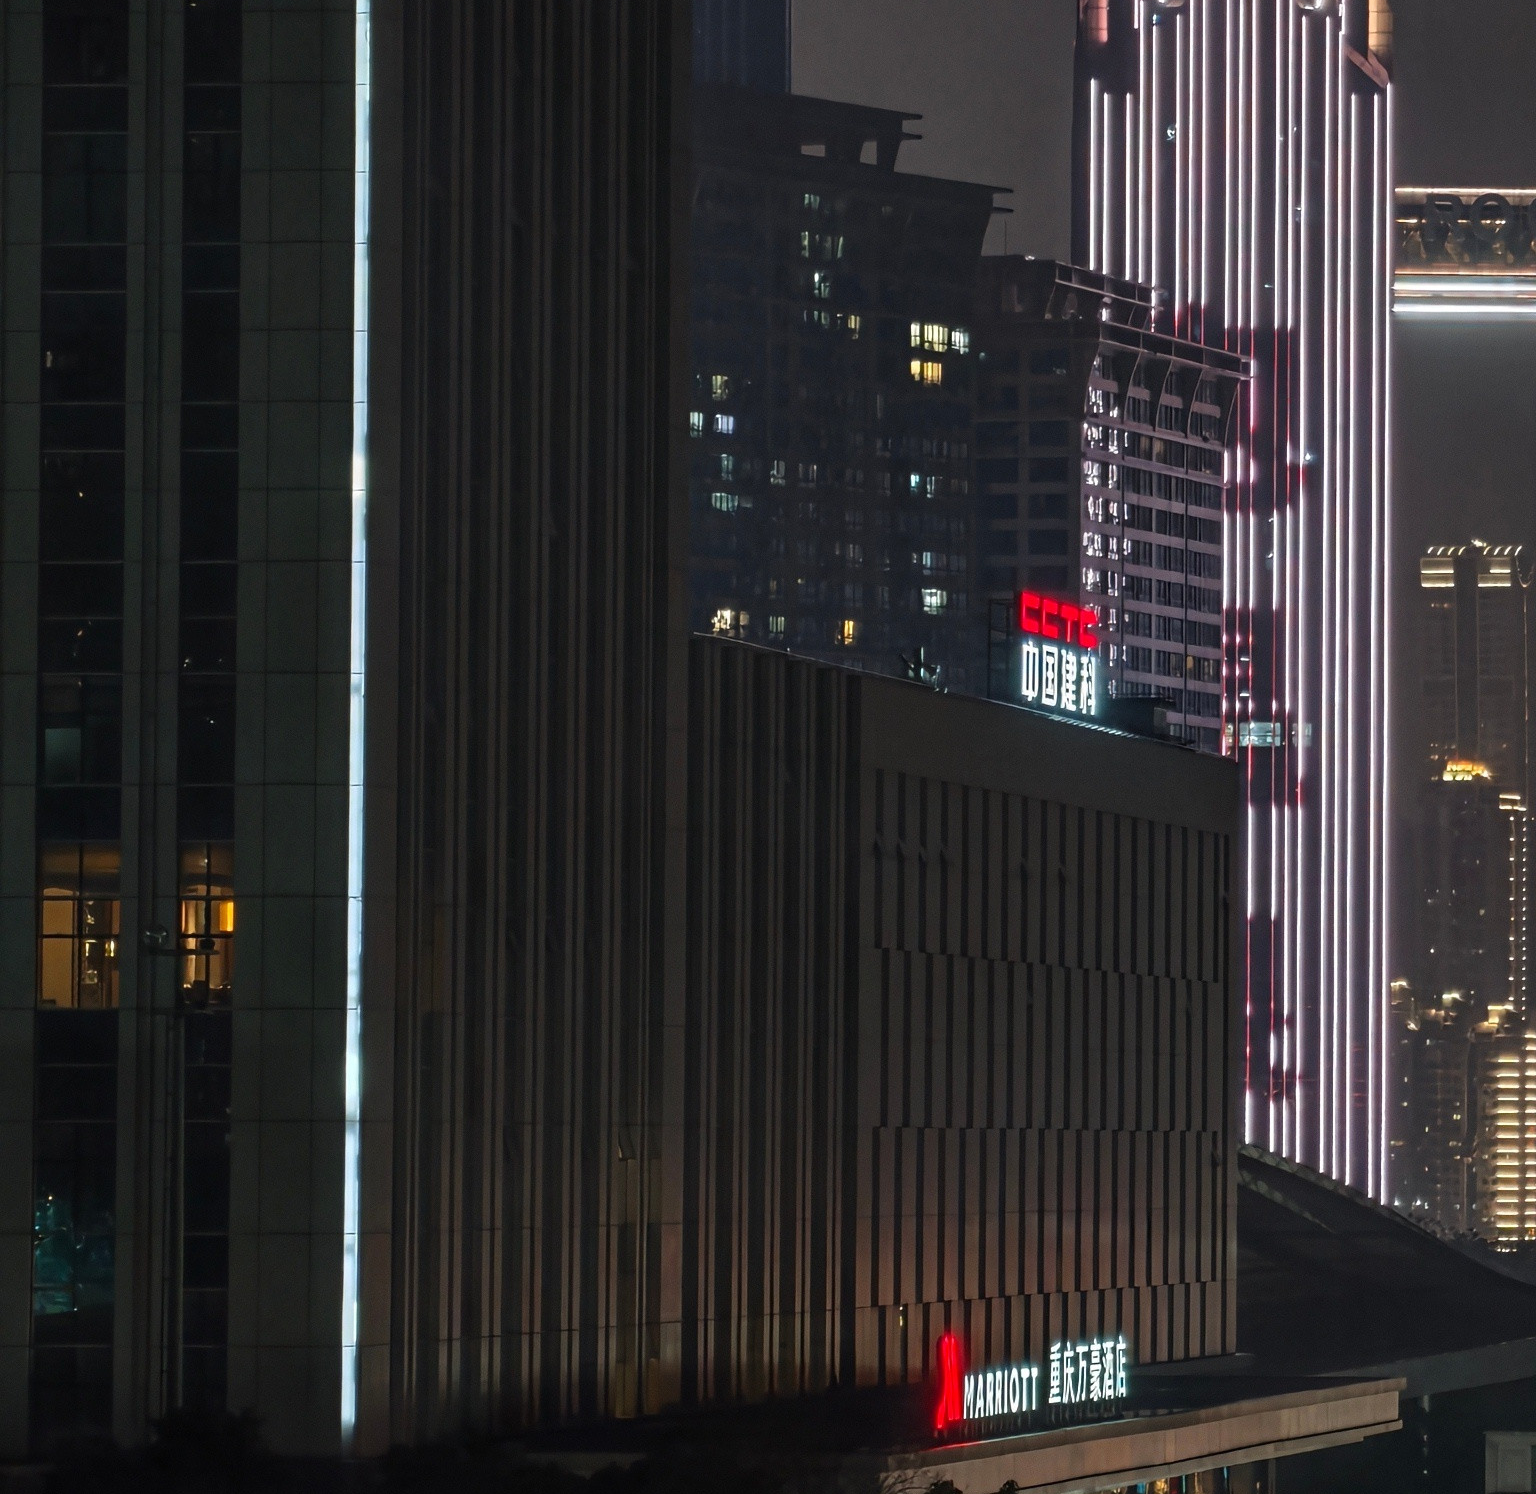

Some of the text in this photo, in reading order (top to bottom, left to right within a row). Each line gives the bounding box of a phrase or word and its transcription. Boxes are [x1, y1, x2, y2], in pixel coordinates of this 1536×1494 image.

[1021, 640, 1096, 716] 中国建科
[963, 1366, 1039, 1420] MARRIOTT
[1049, 1336, 1127, 1404] 重庆万豪酒店
